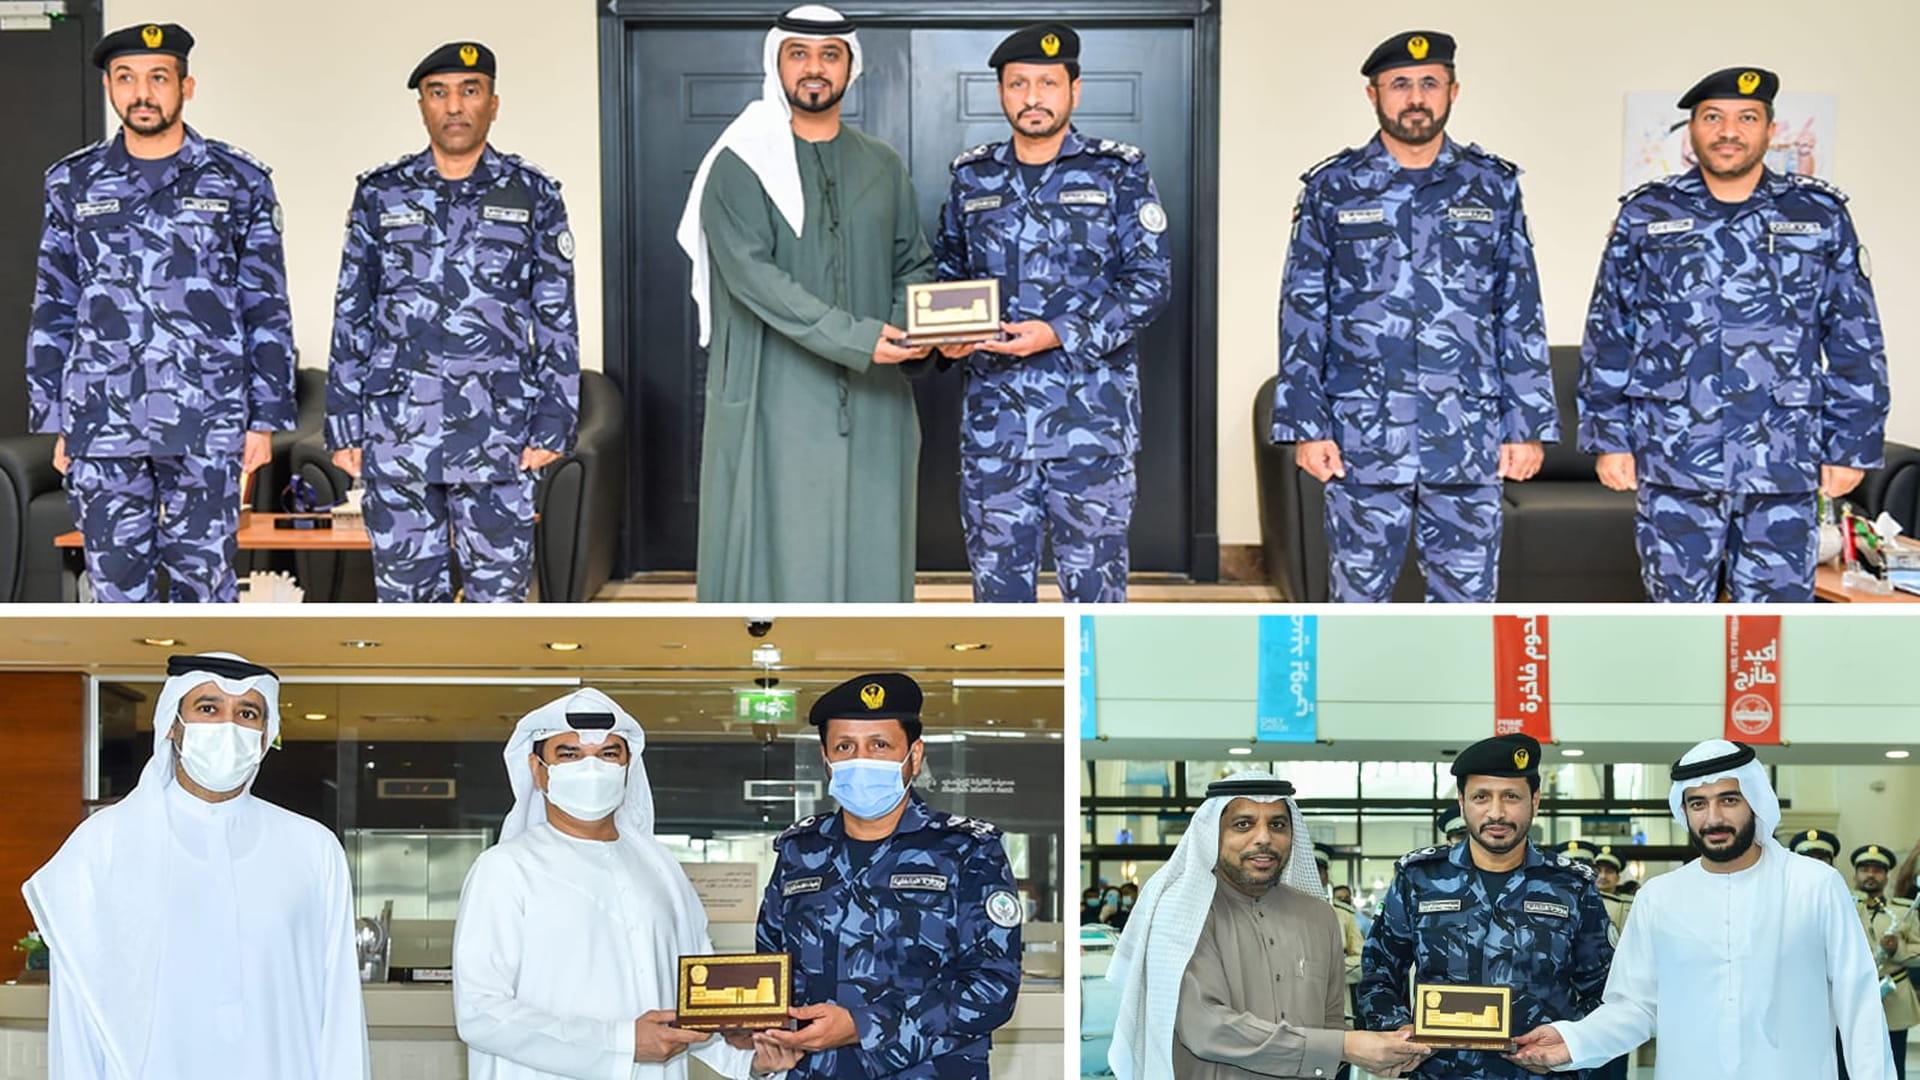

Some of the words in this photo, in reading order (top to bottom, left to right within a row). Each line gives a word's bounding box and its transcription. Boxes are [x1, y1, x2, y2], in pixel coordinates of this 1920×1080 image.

[1290, 661, 1314, 717] يومي
[1517, 663, 1543, 713] فاخرة
[1734, 666, 1776, 691] طازج
